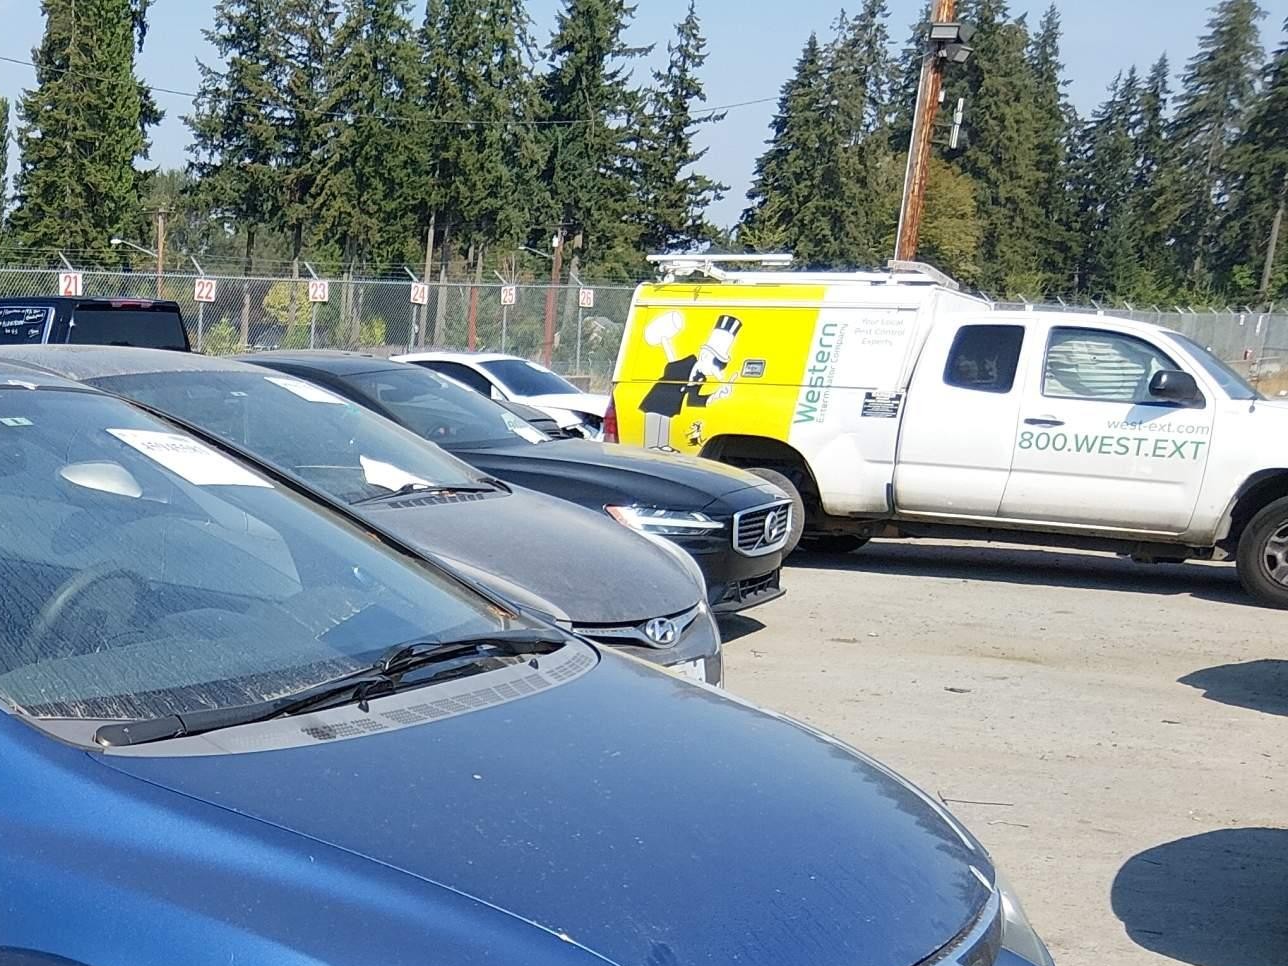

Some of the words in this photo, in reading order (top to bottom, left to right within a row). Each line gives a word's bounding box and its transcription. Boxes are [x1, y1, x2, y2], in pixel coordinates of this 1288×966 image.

[64, 275, 78, 297] 21
[197, 281, 213, 300] 22
[311, 282, 326, 300] 23
[413, 285, 425, 302] 24
[503, 288, 513, 303] 25
[581, 291, 591, 306] 26
[793, 323, 838, 424] Western
[1107, 418, 1210, 436] west-ext.com
[1018, 431, 1206, 460] 800.WEST.EXT
